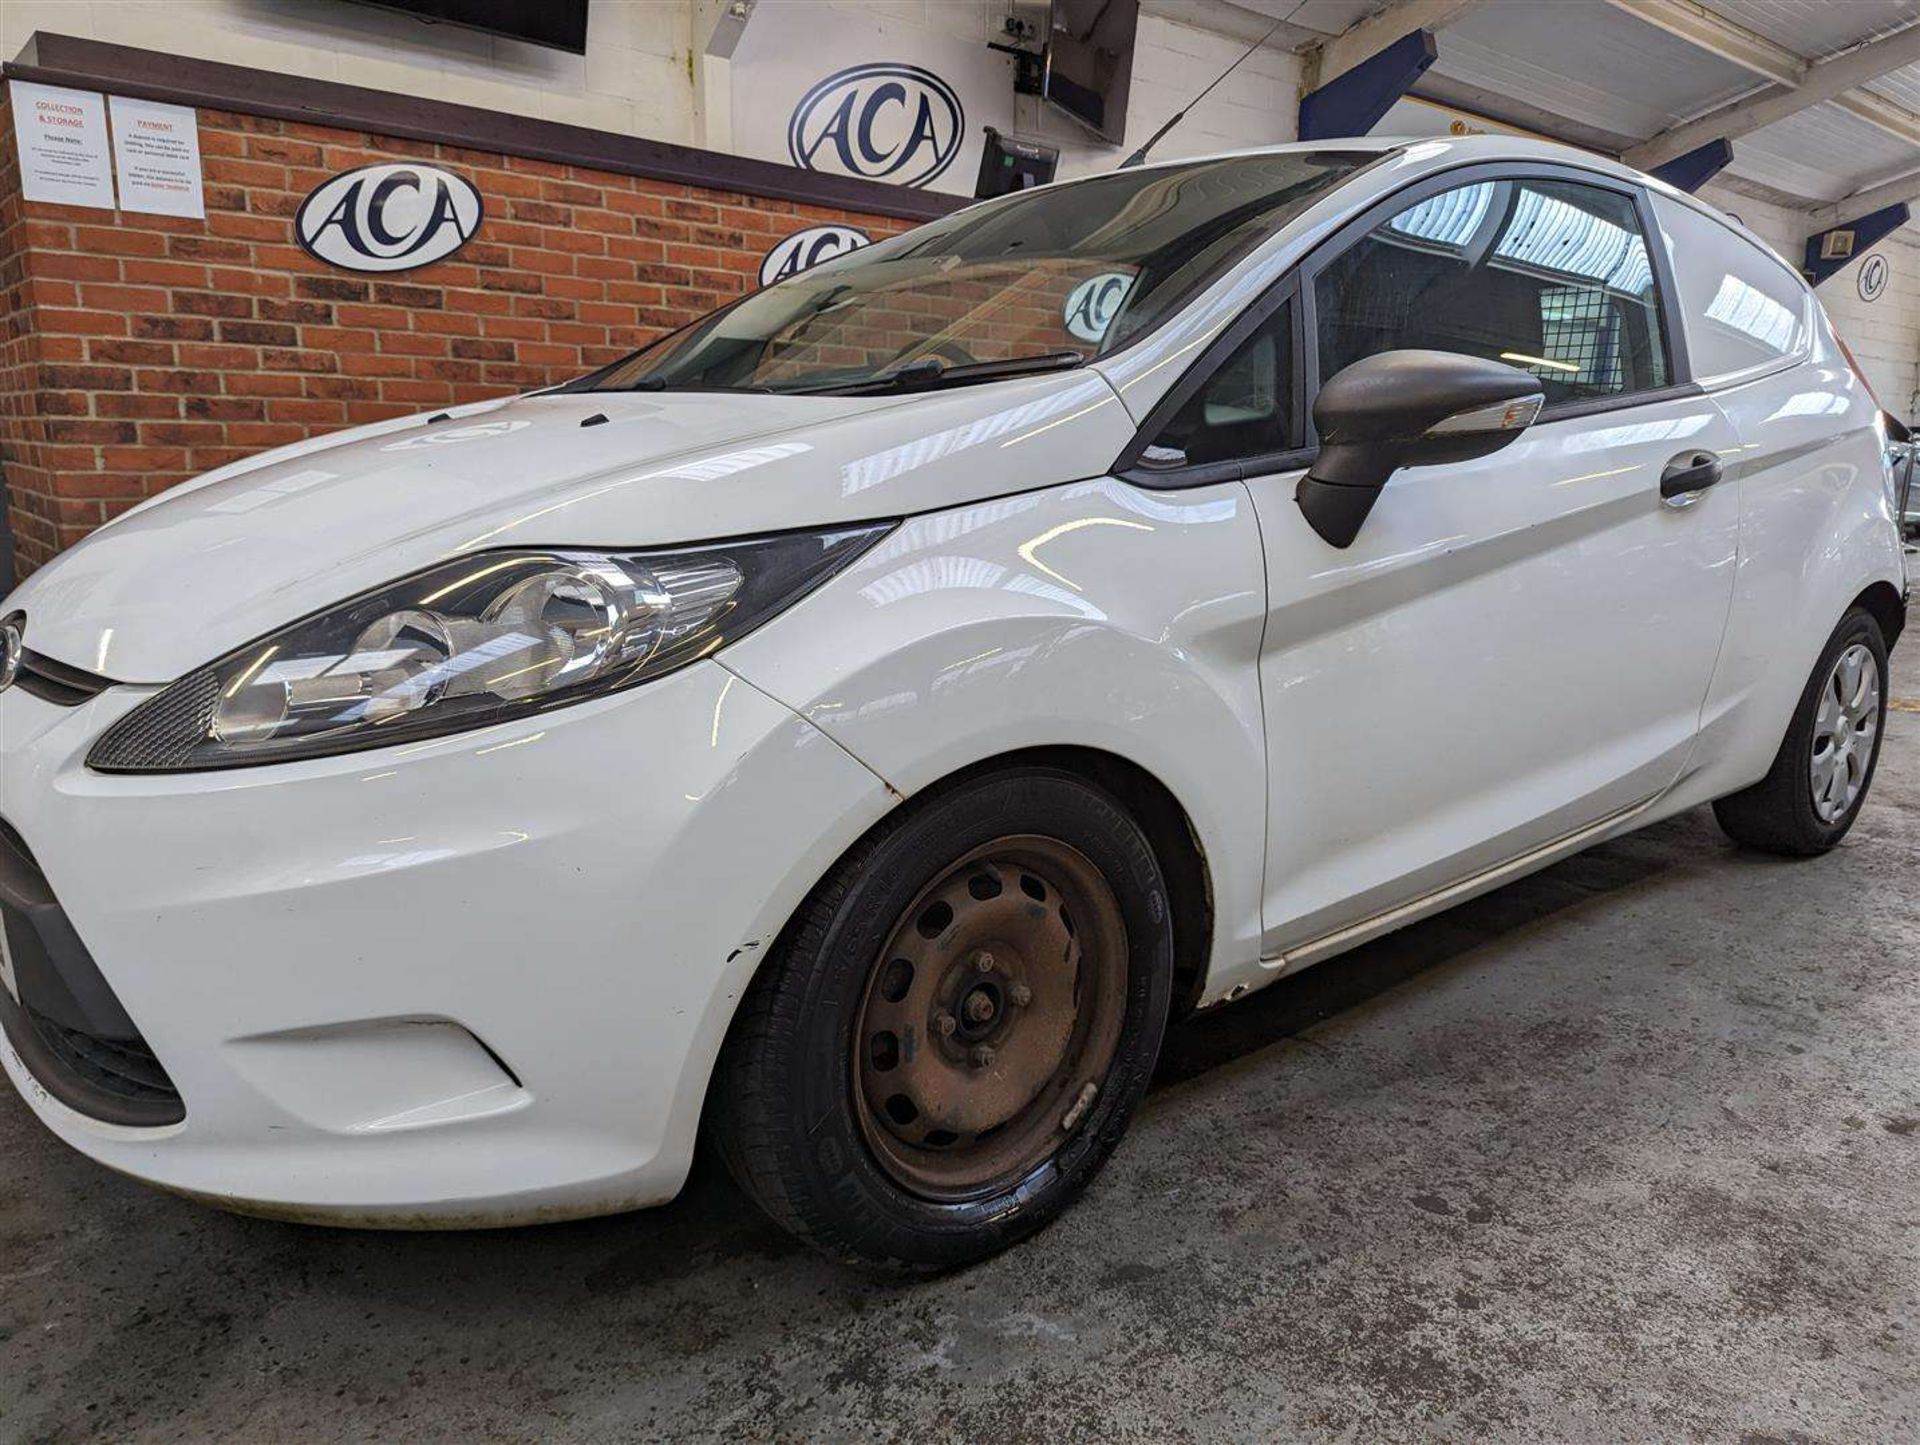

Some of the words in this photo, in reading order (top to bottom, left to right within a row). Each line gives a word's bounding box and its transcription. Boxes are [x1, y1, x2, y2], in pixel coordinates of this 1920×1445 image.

[35, 101, 84, 115] COLLECTION
[137, 120, 173, 132] PAYMENT
[805, 82, 943, 179] ACA
[308, 170, 467, 260] ACA
[772, 232, 858, 283] AC
